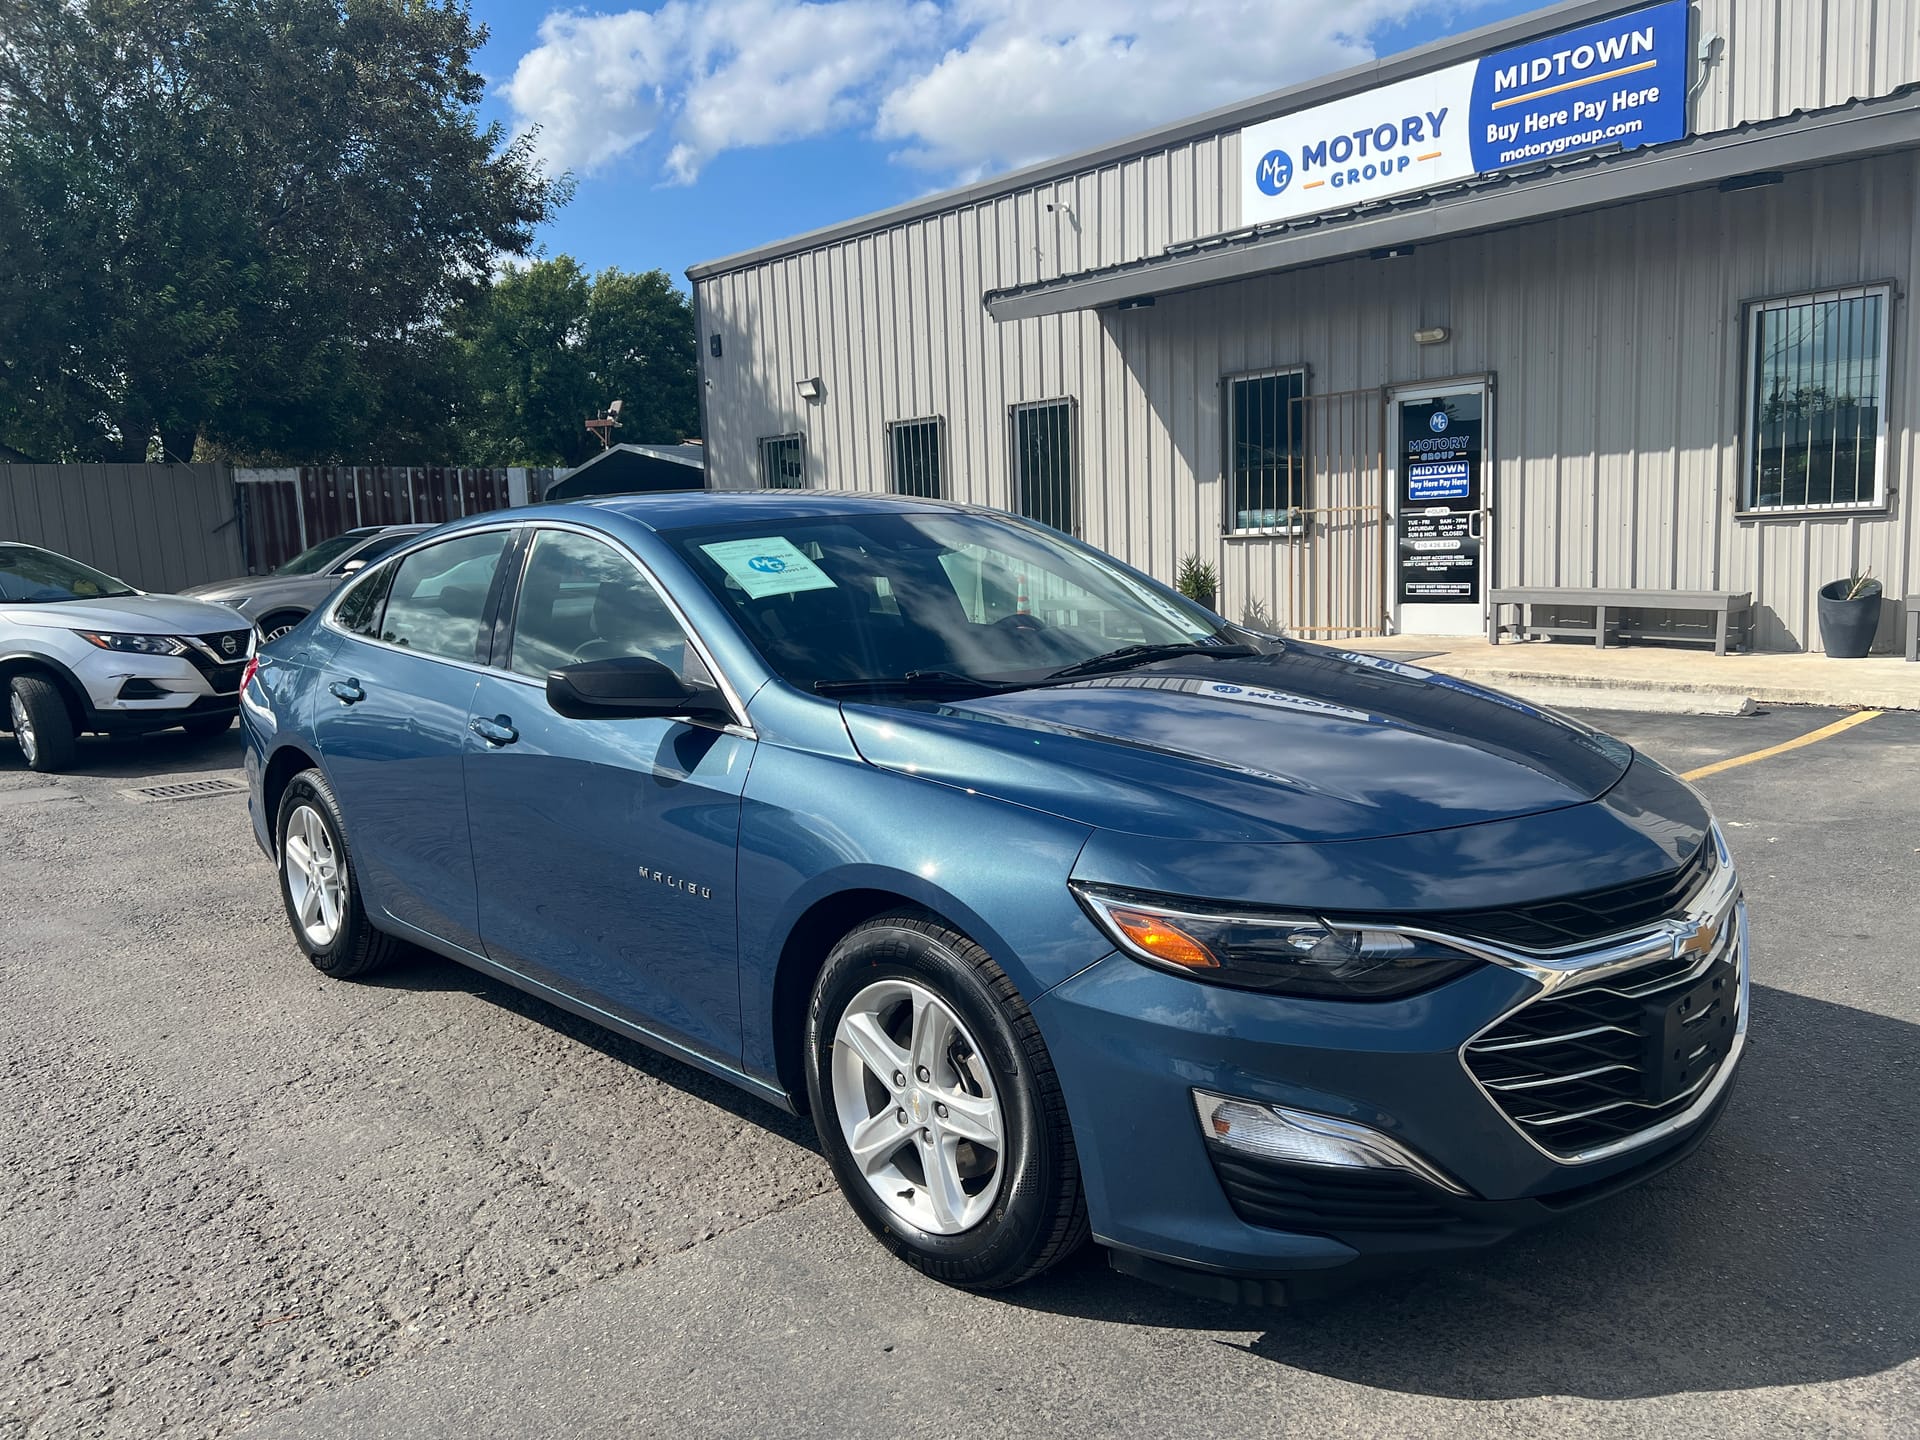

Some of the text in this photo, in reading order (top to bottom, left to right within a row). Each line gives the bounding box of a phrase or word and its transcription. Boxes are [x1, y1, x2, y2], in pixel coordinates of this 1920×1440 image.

[1494, 26, 1655, 93] MIDTOWN
[1487, 86, 1660, 144] Buy Here Pay Here
[1302, 107, 1448, 171] MOTORY
[1500, 117, 1643, 163] motorygroup.com
[1331, 155, 1411, 188] GROUP
[1409, 435, 1469, 452] MOTORY
[1421, 451, 1454, 460] GROUP
[1411, 481, 1422, 489] Buy
[1439, 479, 1450, 487] Pay
[1412, 464, 1465, 475] MIDTOWN
[1415, 489, 1462, 497] motorygroup.com
[639, 866, 711, 899] MALIBU
